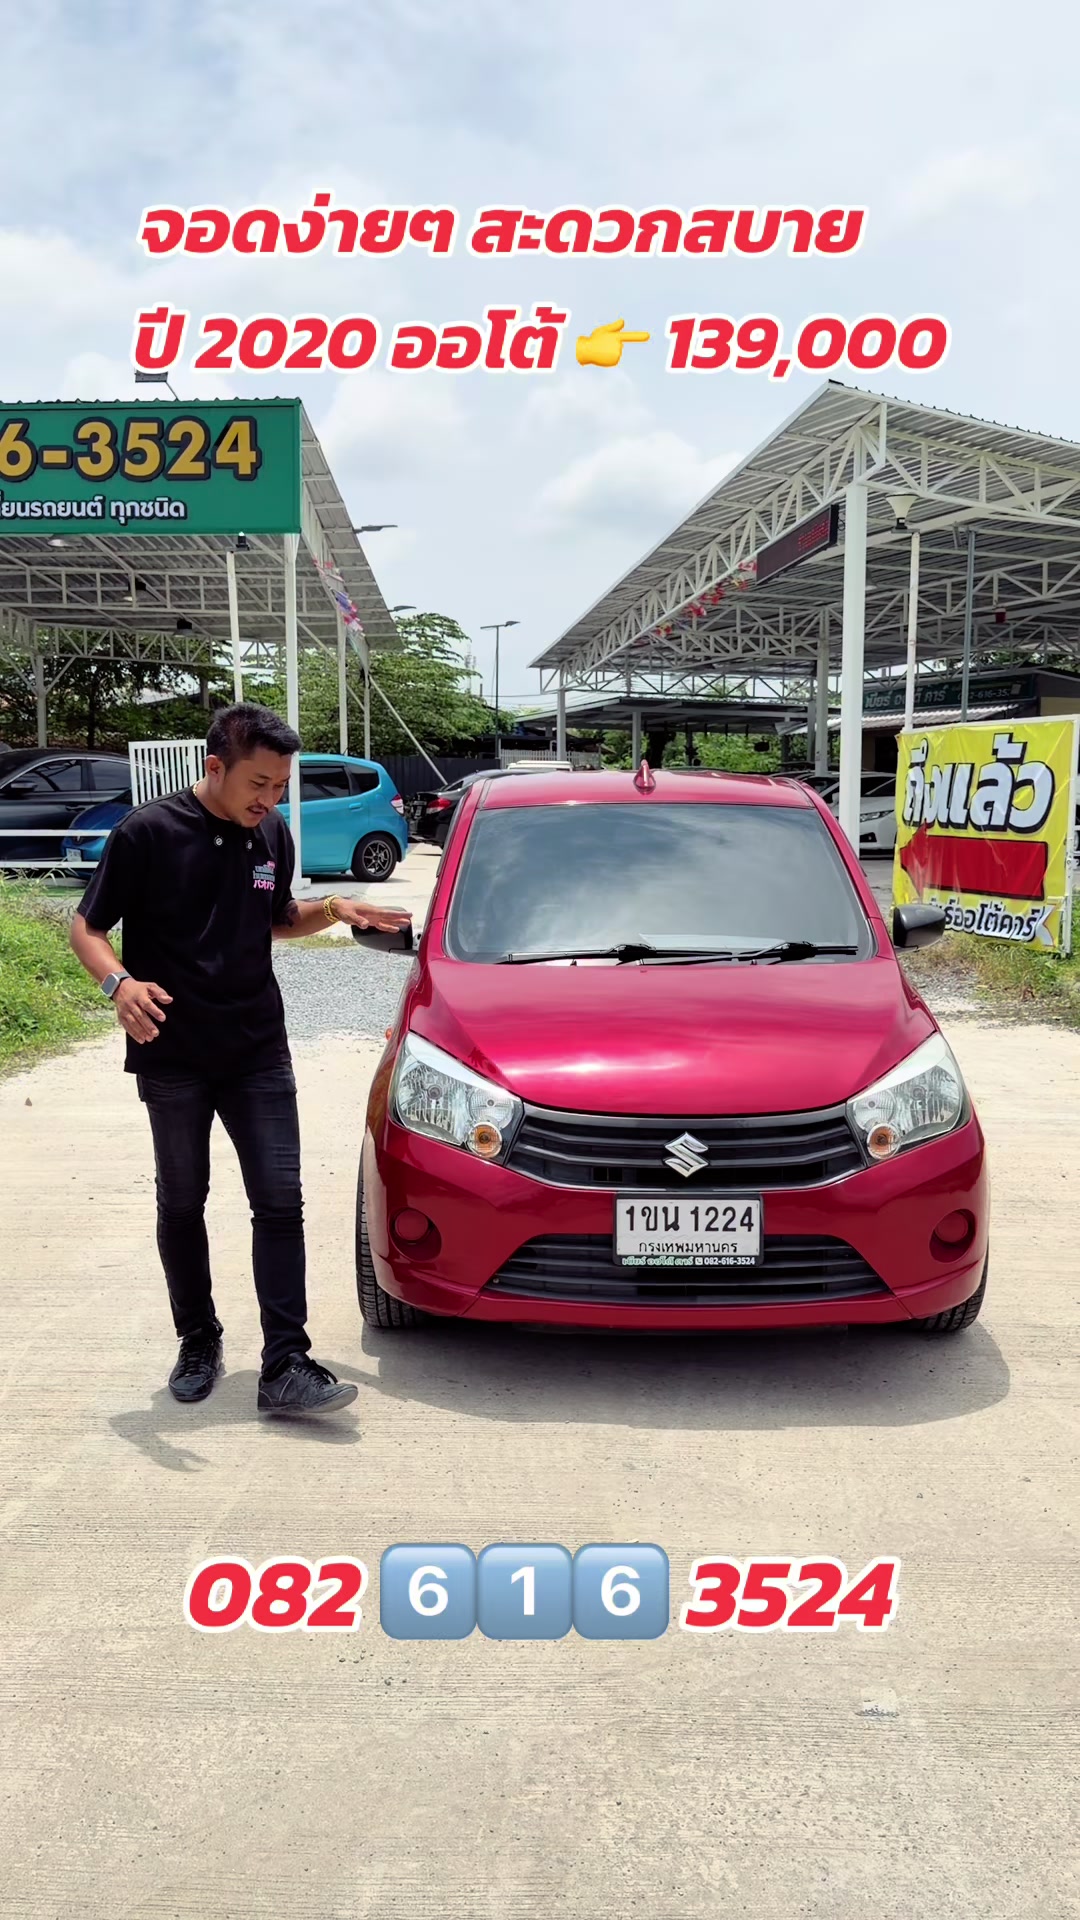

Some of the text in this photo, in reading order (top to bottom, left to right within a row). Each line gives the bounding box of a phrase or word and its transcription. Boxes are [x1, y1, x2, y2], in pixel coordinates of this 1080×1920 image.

[0, 494, 186, 525] ยนรถยนต์ ทุกชนิด
[625, 1204, 755, 1233] 1ขน 1224
[639, 1241, 739, 1256] กรุงเทพมหานคร
[703, 1256, 756, 1266] 082-616-3524
